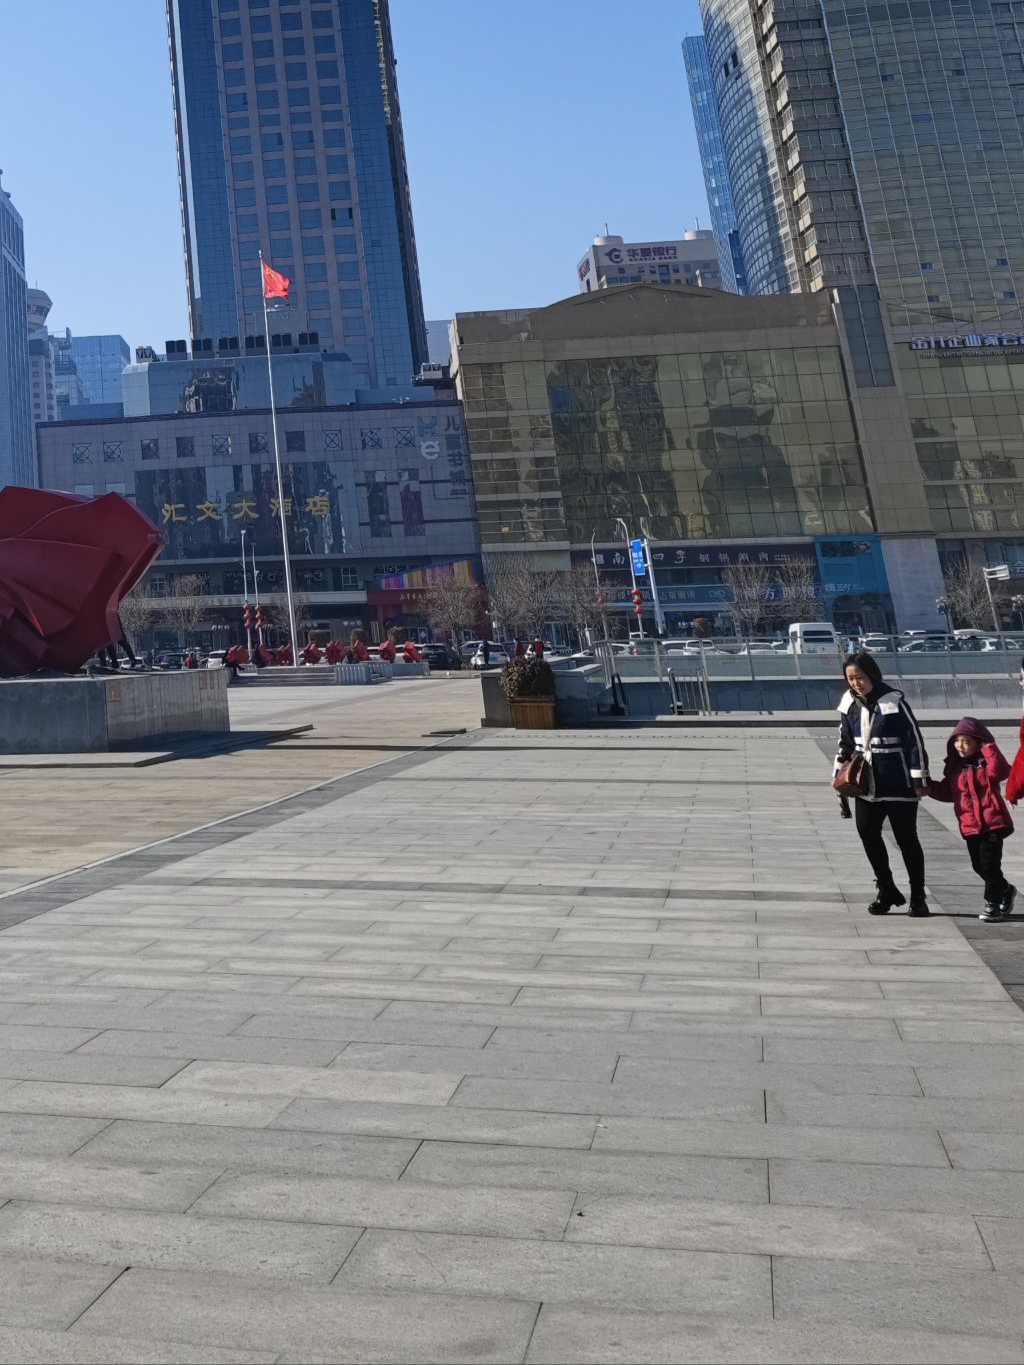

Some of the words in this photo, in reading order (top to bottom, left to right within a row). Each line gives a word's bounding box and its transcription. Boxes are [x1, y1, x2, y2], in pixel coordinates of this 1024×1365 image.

[627, 246, 678, 258] 华夏银行
[162, 495, 330, 524] 汇文大酒店
